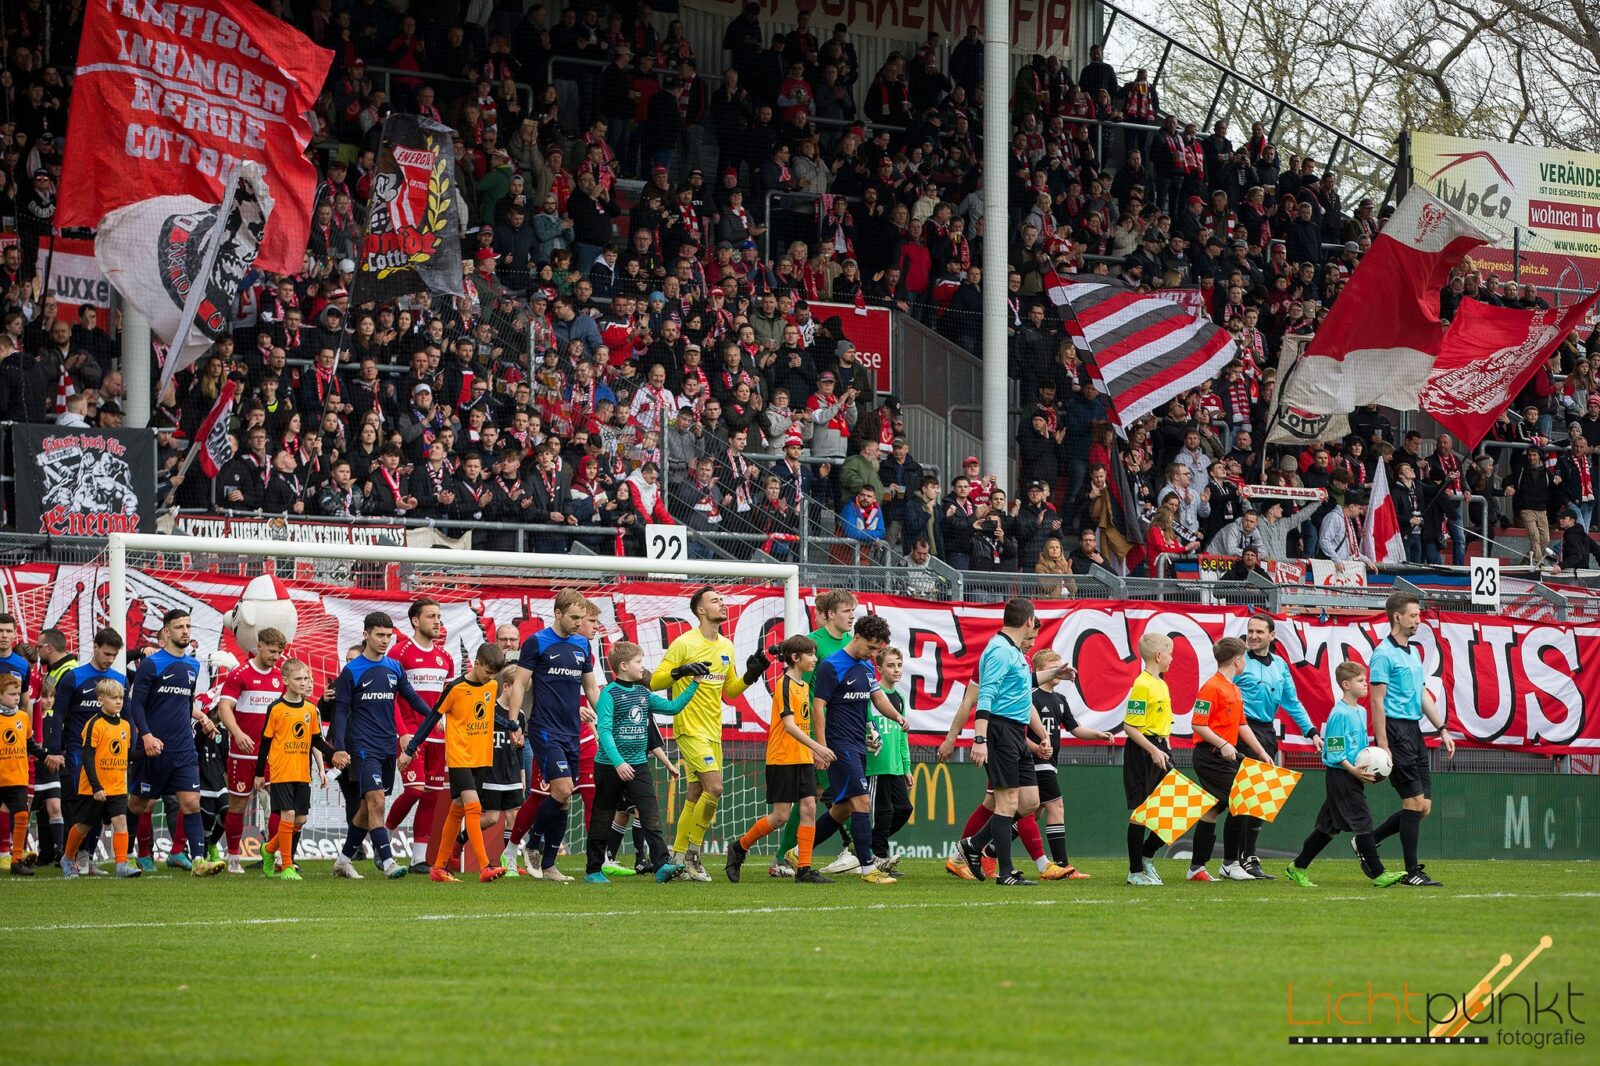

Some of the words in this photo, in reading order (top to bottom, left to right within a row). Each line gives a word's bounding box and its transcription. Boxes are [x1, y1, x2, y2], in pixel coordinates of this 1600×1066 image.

[131, 77, 266, 150] ENERGIE
[1549, 187, 1558, 196] DIE
[1558, 188, 1587, 199] SICHERSTE
[1531, 204, 1578, 227] wohnen
[1582, 208, 1593, 228] in
[178, 518, 225, 538] AKTIVE
[288, 523, 350, 545] FRONTSIDE
[653, 535, 682, 560] 22
[1474, 566, 1496, 596] 23
[888, 841, 932, 858] Team
